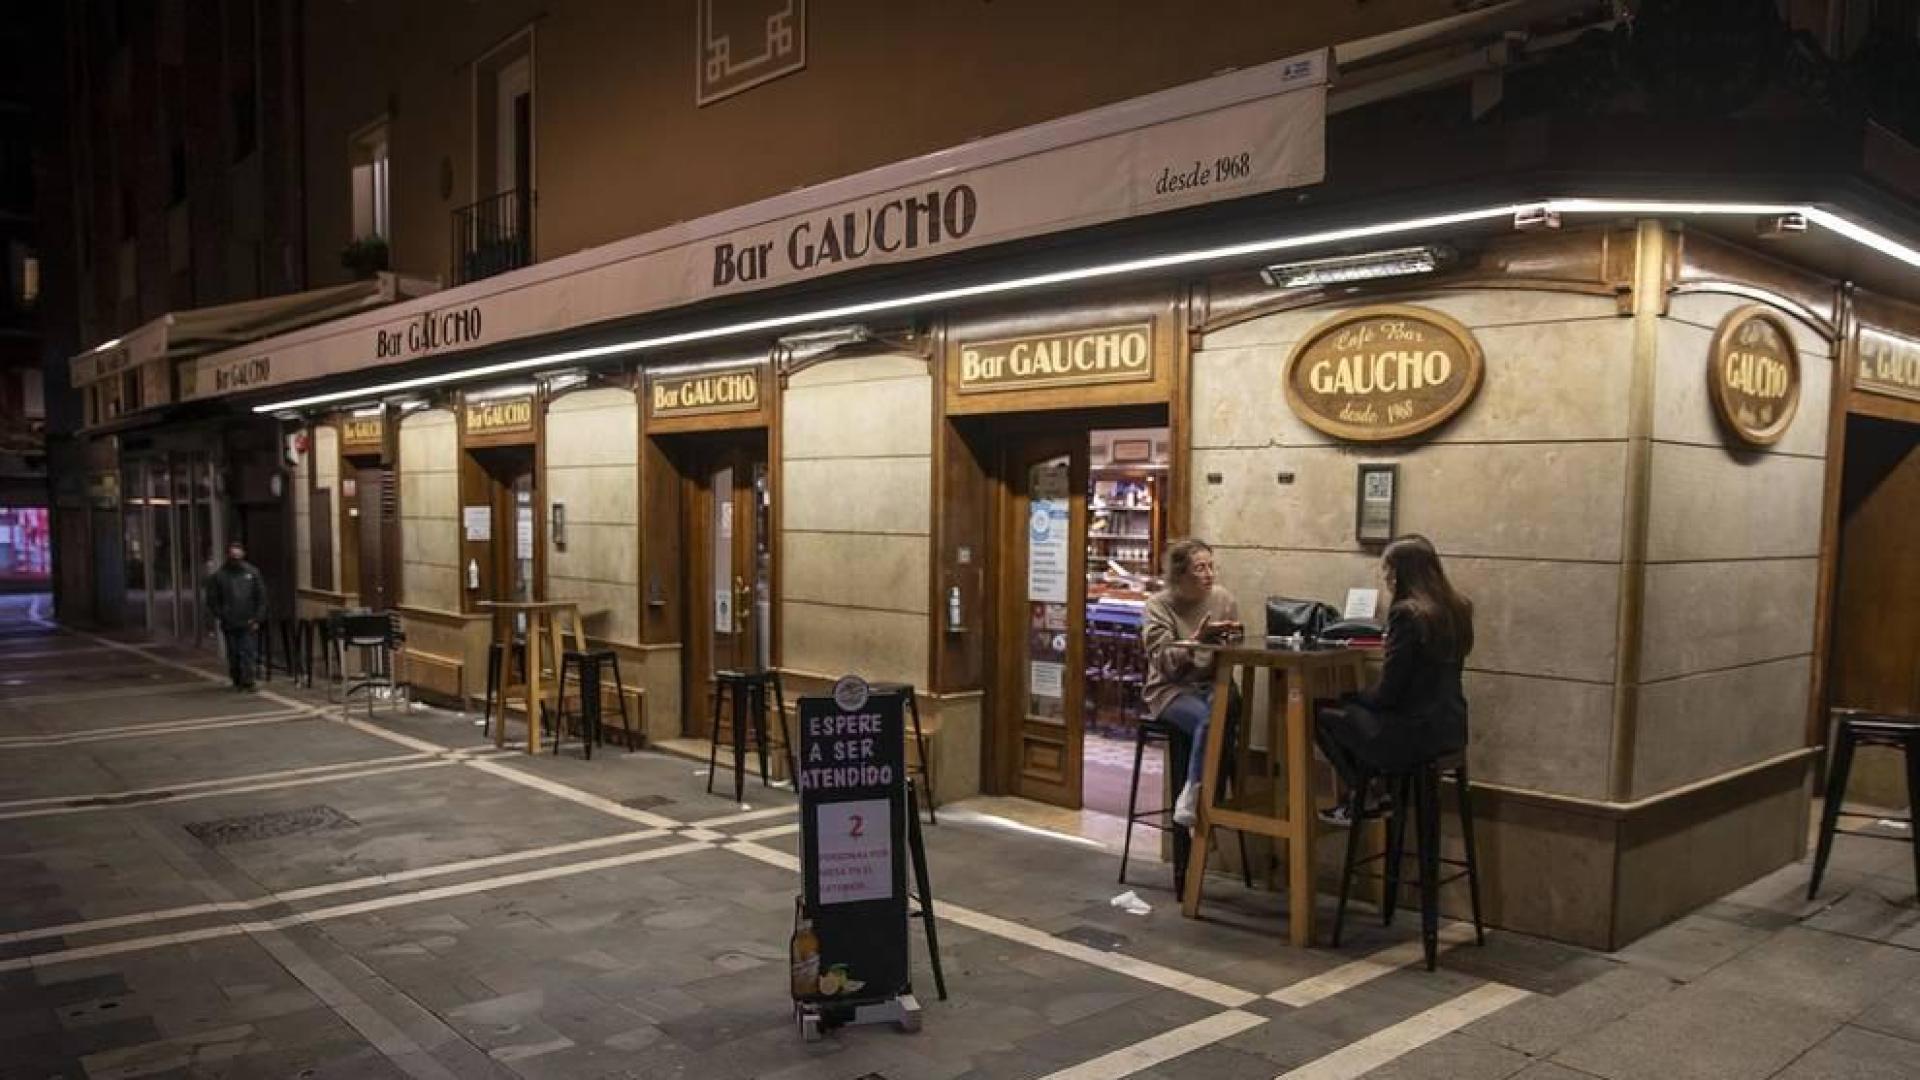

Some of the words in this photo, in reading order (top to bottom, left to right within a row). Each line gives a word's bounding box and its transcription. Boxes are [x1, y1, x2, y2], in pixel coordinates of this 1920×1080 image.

[1155, 160, 1211, 195] desde
[1214, 152, 1251, 183] 1968
[713, 241, 775, 288] Bar
[787, 184, 977, 271] GAUCHO
[376, 329, 402, 358] Bar
[408, 307, 482, 353] GAUCHO
[962, 350, 1007, 381] Bar
[1009, 332, 1147, 377] GAUCHO
[1309, 350, 1452, 395] GAUCHO
[1726, 352, 1788, 398] GAUCHO
[655, 385, 679, 408] Bar
[681, 375, 757, 406] GAUCHO
[809, 713, 883, 736] ESPERE
[809, 742, 823, 762] A
[833, 738, 875, 761] SER
[800, 762, 893, 789] ATENDIDO
[849, 815, 864, 837] 2
